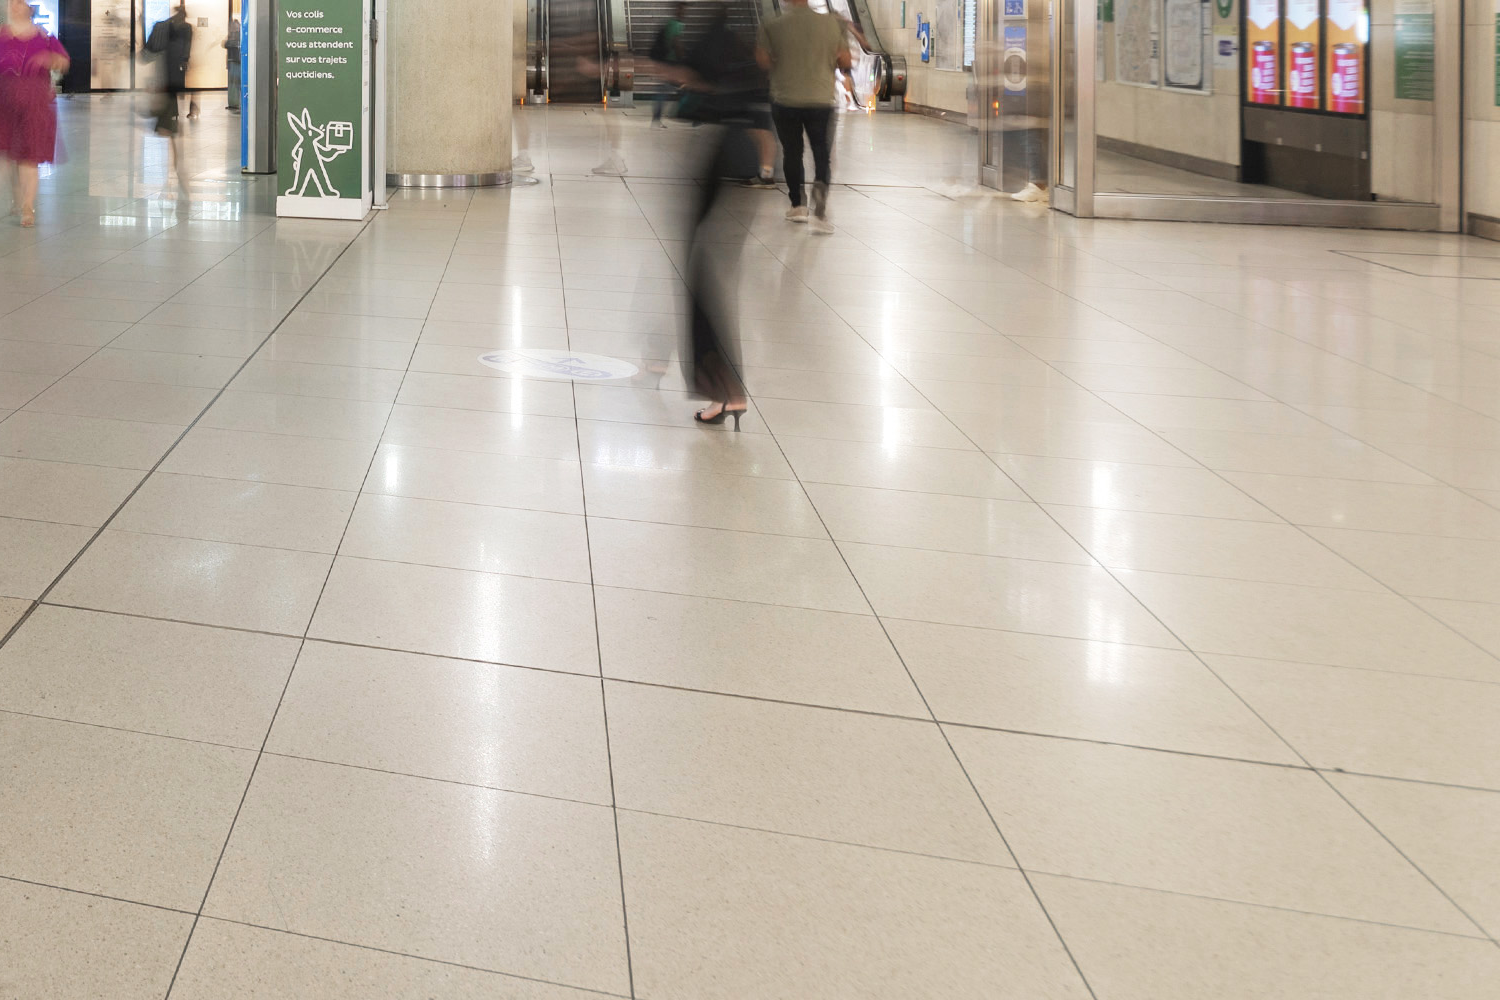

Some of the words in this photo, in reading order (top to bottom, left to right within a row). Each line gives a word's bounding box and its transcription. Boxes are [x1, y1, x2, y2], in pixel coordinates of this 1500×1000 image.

[286, 10, 302, 18] Vos
[303, 10, 324, 18] colis
[318, 56, 347, 65] trajets
[286, 70, 335, 79] quotidiens.
